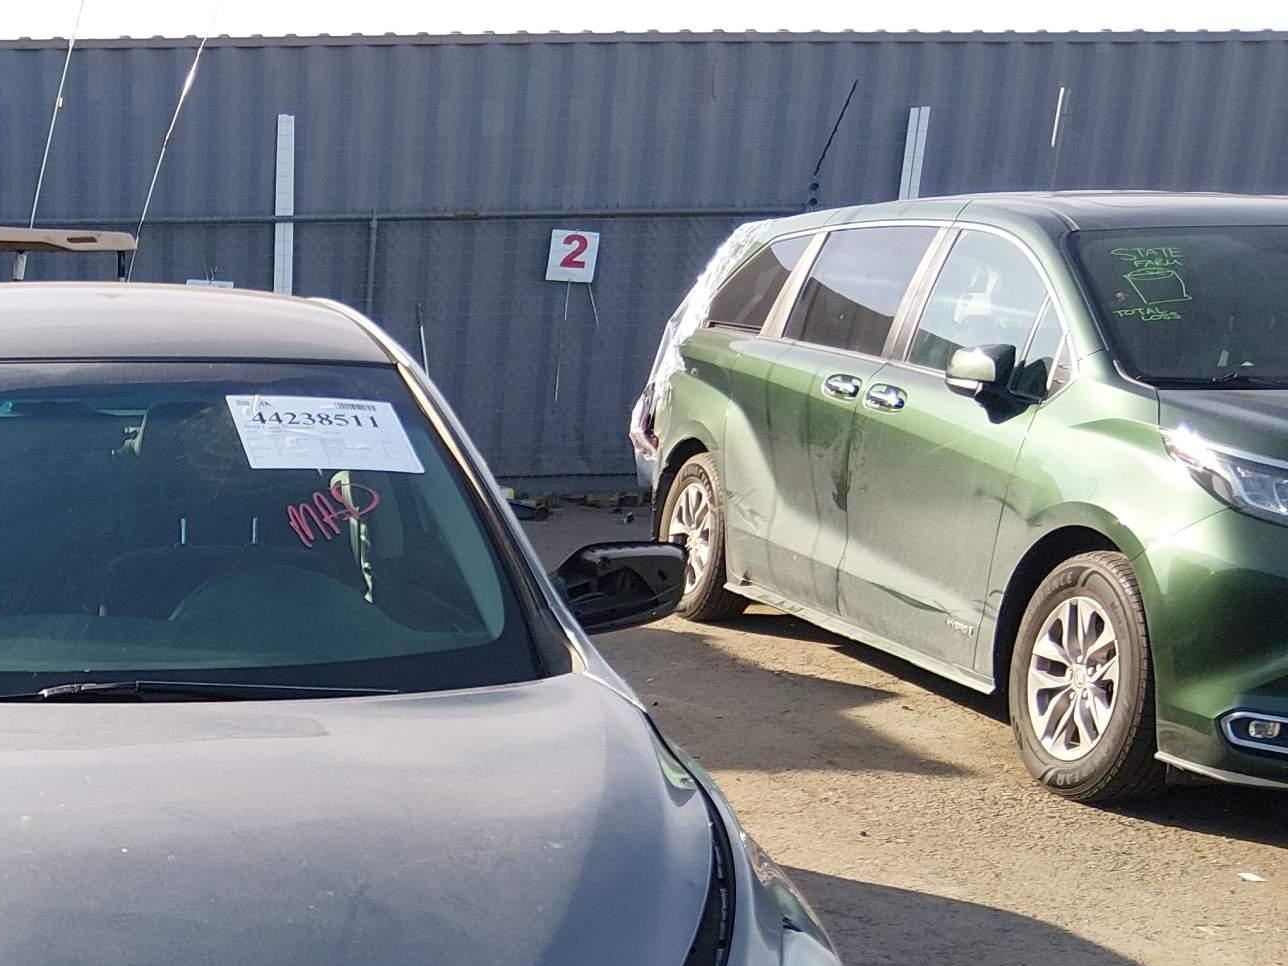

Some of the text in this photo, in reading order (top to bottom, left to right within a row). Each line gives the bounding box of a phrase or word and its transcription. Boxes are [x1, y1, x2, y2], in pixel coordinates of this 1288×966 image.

[560, 234, 588, 269] 2
[1110, 247, 1184, 261] STATE
[1134, 258, 1184, 268] FARM
[1112, 307, 1168, 317] TOTAL
[1141, 312, 1181, 321] LOSS
[251, 411, 379, 429] 44238511
